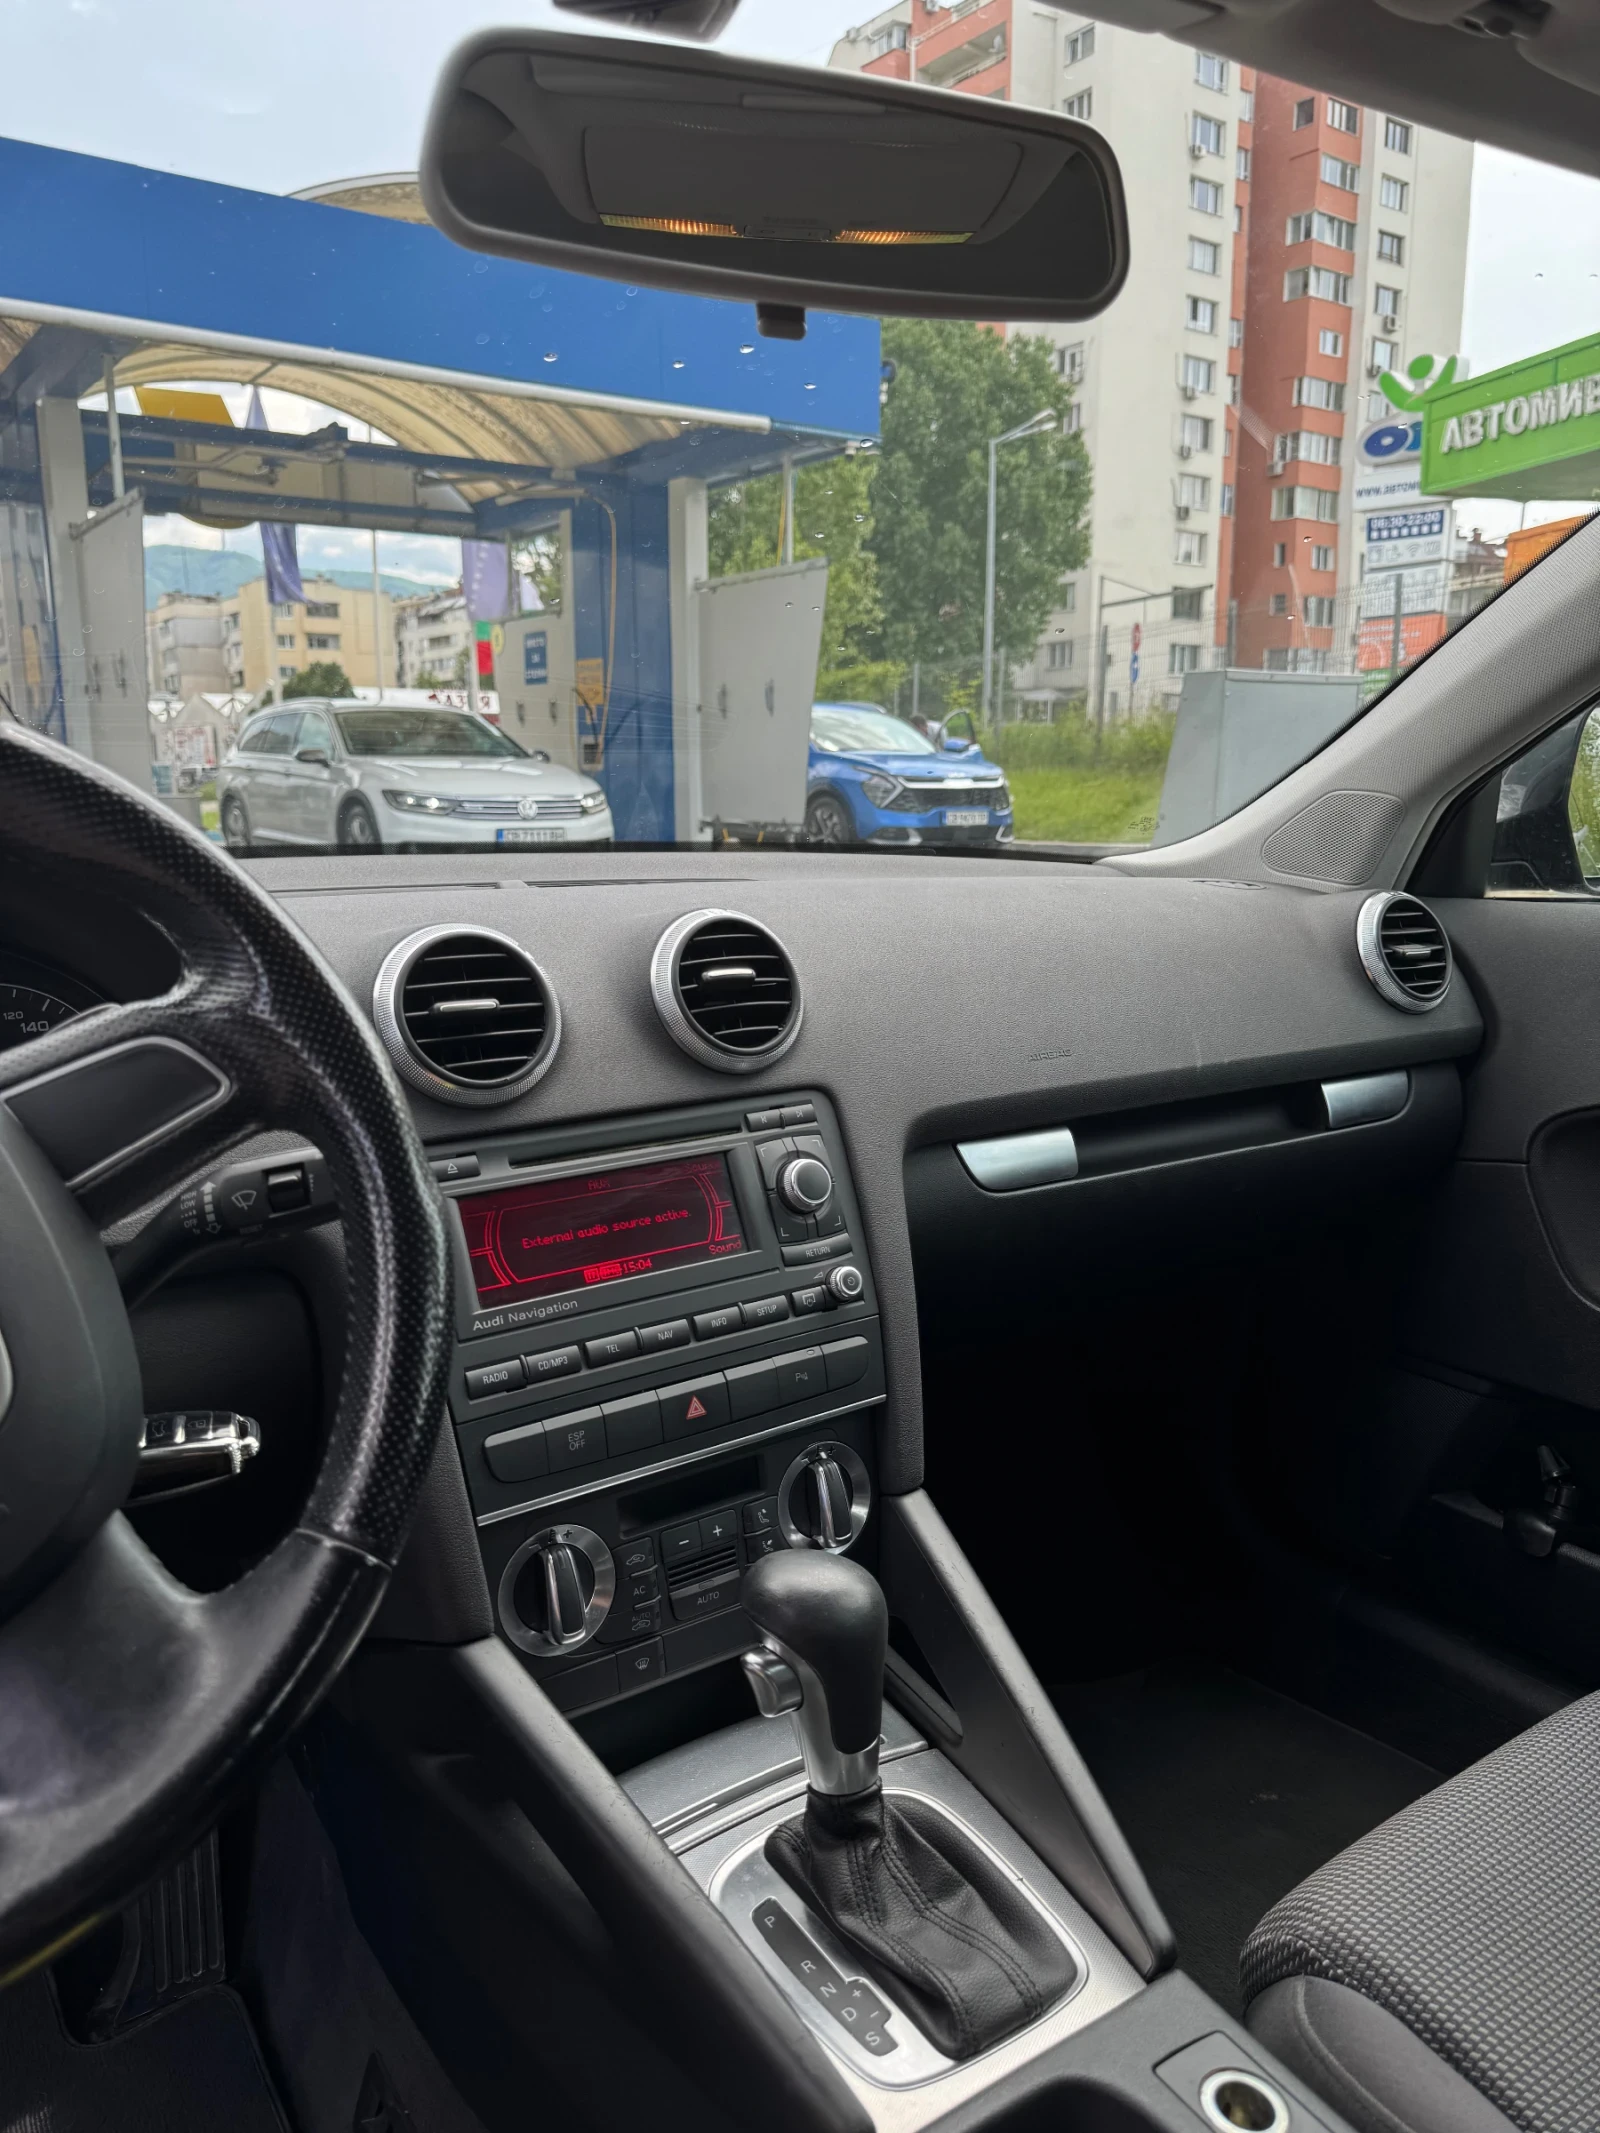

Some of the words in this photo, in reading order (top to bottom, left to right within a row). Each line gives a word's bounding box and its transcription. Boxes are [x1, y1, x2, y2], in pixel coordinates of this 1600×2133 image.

[3, 1011, 24, 1020] 120
[20, 1021, 50, 1033] 140
[180, 1200, 196, 1210] LOW
[184, 1218, 199, 1229] OFF
[522, 1230, 574, 1249] External
[577, 1223, 608, 1239] audio
[612, 1215, 652, 1232] source
[709, 1240, 742, 1255] Sound
[805, 1246, 831, 1258] RETURN
[623, 1259, 653, 1274] 15:04
[473, 1316, 504, 1331] Audi
[508, 1300, 579, 1324] Navigation
[757, 1305, 777, 1316] SETUP
[711, 1317, 727, 1328] INFO
[657, 1329, 673, 1341] NAV
[606, 1344, 620, 1354] TEL
[483, 1371, 508, 1385] RADIO
[568, 1430, 585, 1442] ESP
[569, 1439, 585, 1451] OFF
[633, 1585, 646, 1596] AC
[697, 1591, 720, 1605] AUTO
[764, 1915, 776, 1928] P
[800, 1960, 817, 1973] R
[820, 1982, 837, 1998] N
[841, 2007, 857, 2022] D
[865, 2031, 881, 2046] S
